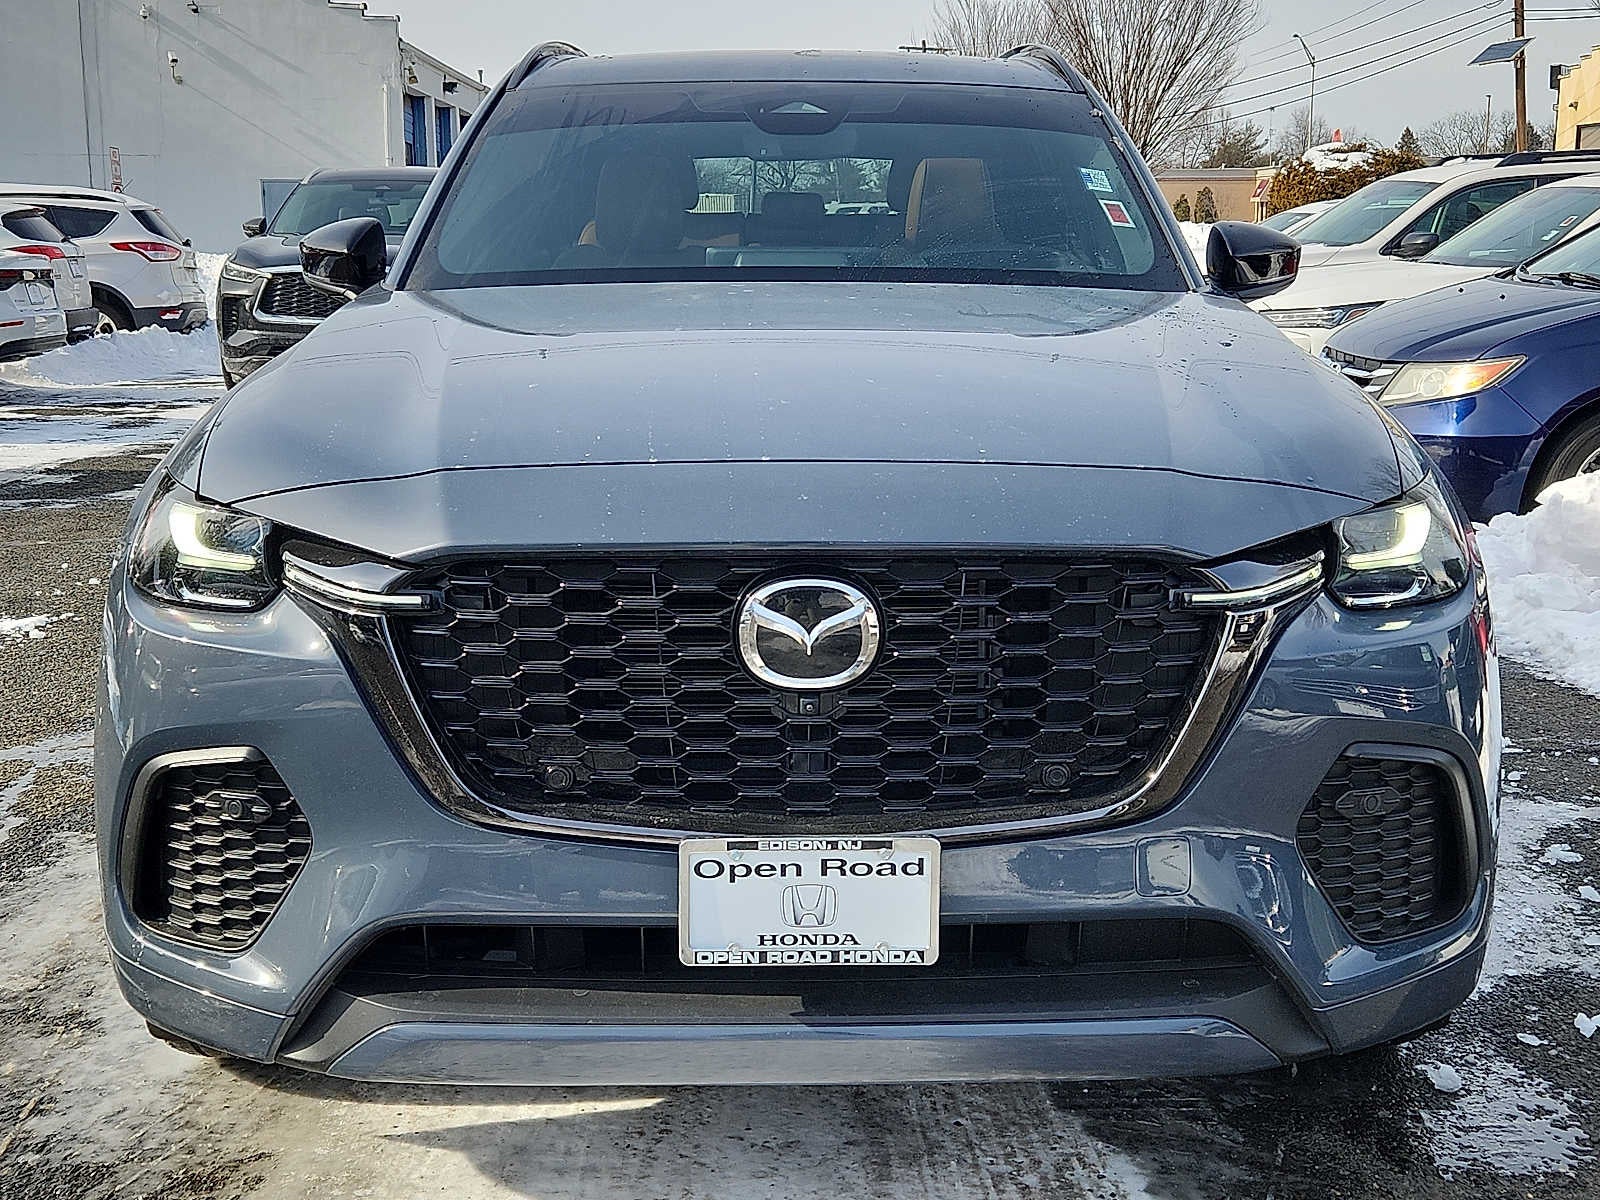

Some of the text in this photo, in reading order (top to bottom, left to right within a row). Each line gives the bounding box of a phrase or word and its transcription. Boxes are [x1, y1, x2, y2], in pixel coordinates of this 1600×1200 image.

[838, 840, 862, 850] NJ
[693, 858, 925, 883] Open Road
[757, 933, 861, 947] HONDA
[696, 950, 922, 964] OPEN ROAD HONDA
